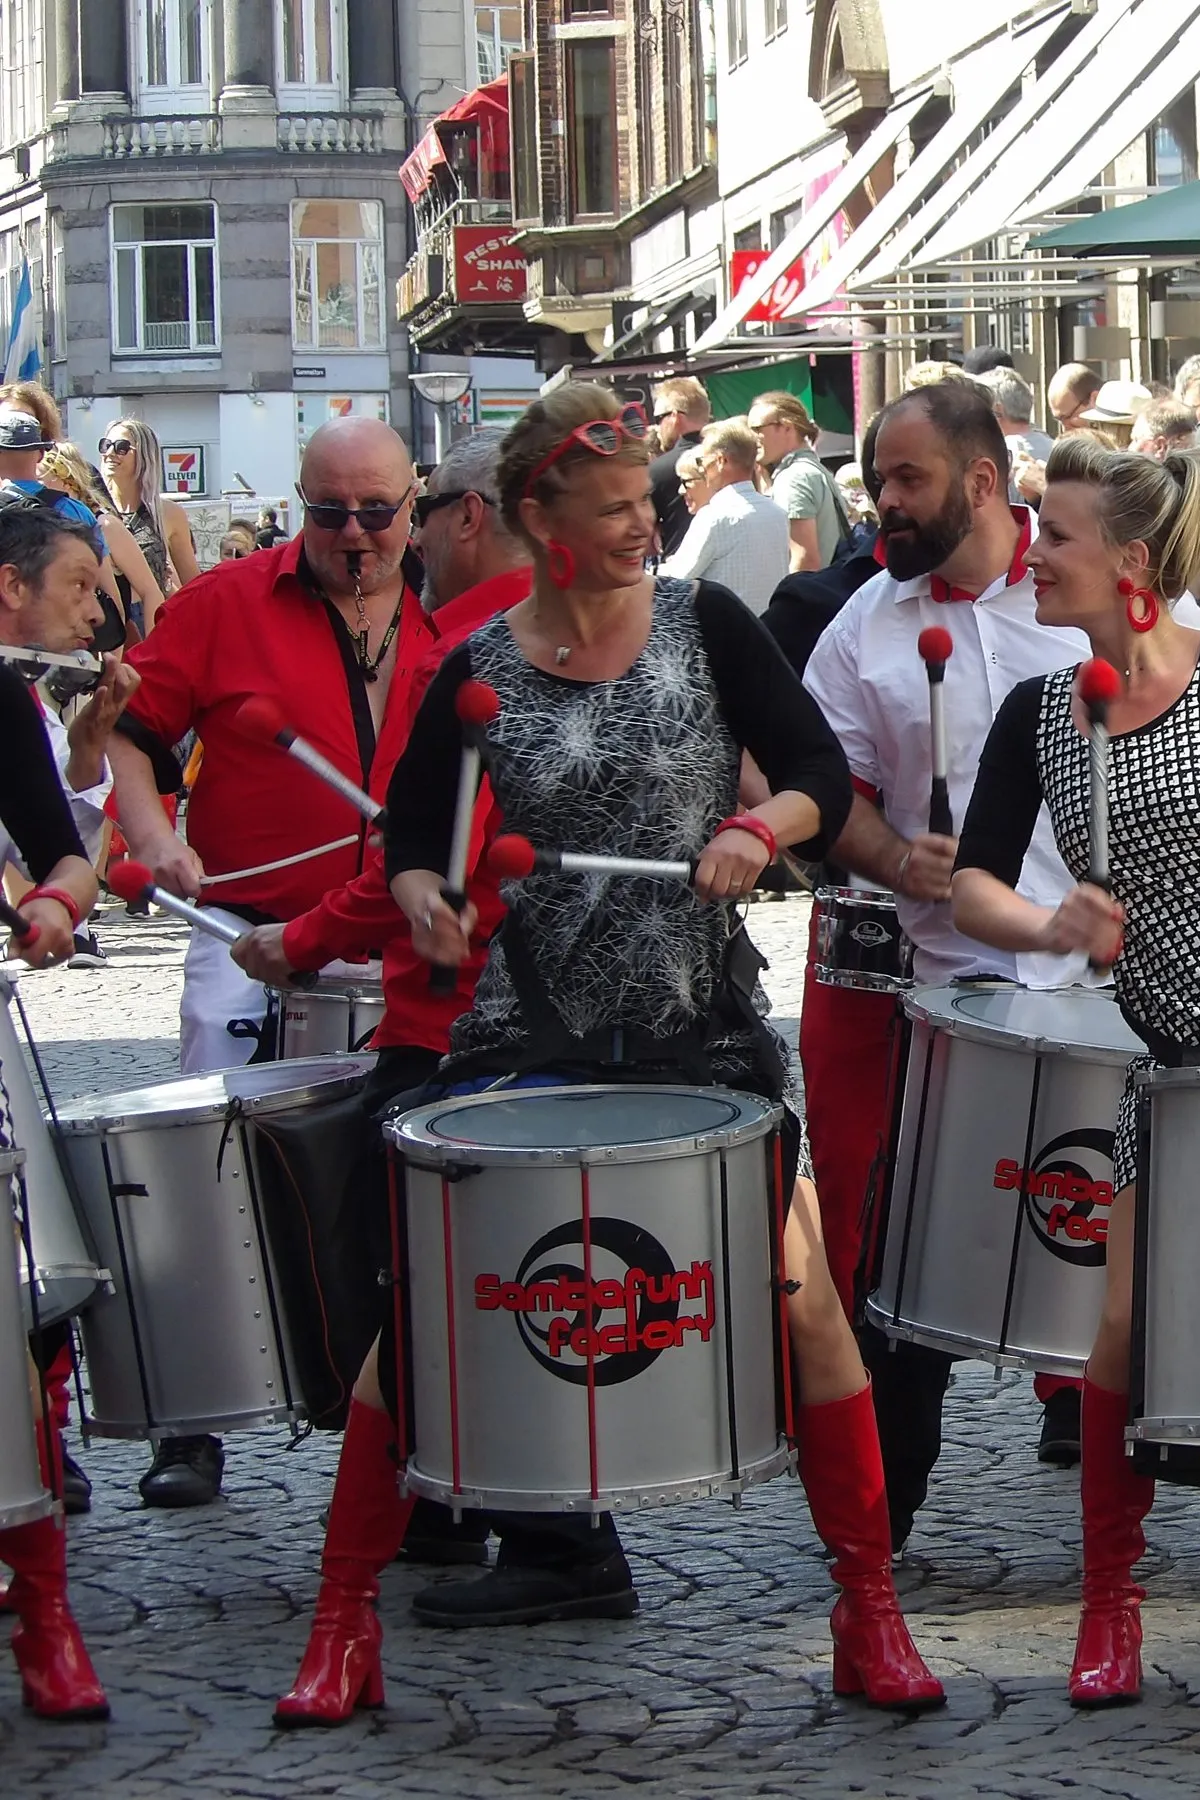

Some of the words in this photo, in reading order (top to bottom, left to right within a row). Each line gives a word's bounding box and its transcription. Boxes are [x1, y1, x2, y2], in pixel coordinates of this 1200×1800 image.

[477, 259, 528, 271] SHAN
[474, 1260, 715, 1313] Sambafunk
[547, 1316, 715, 1357] factory
